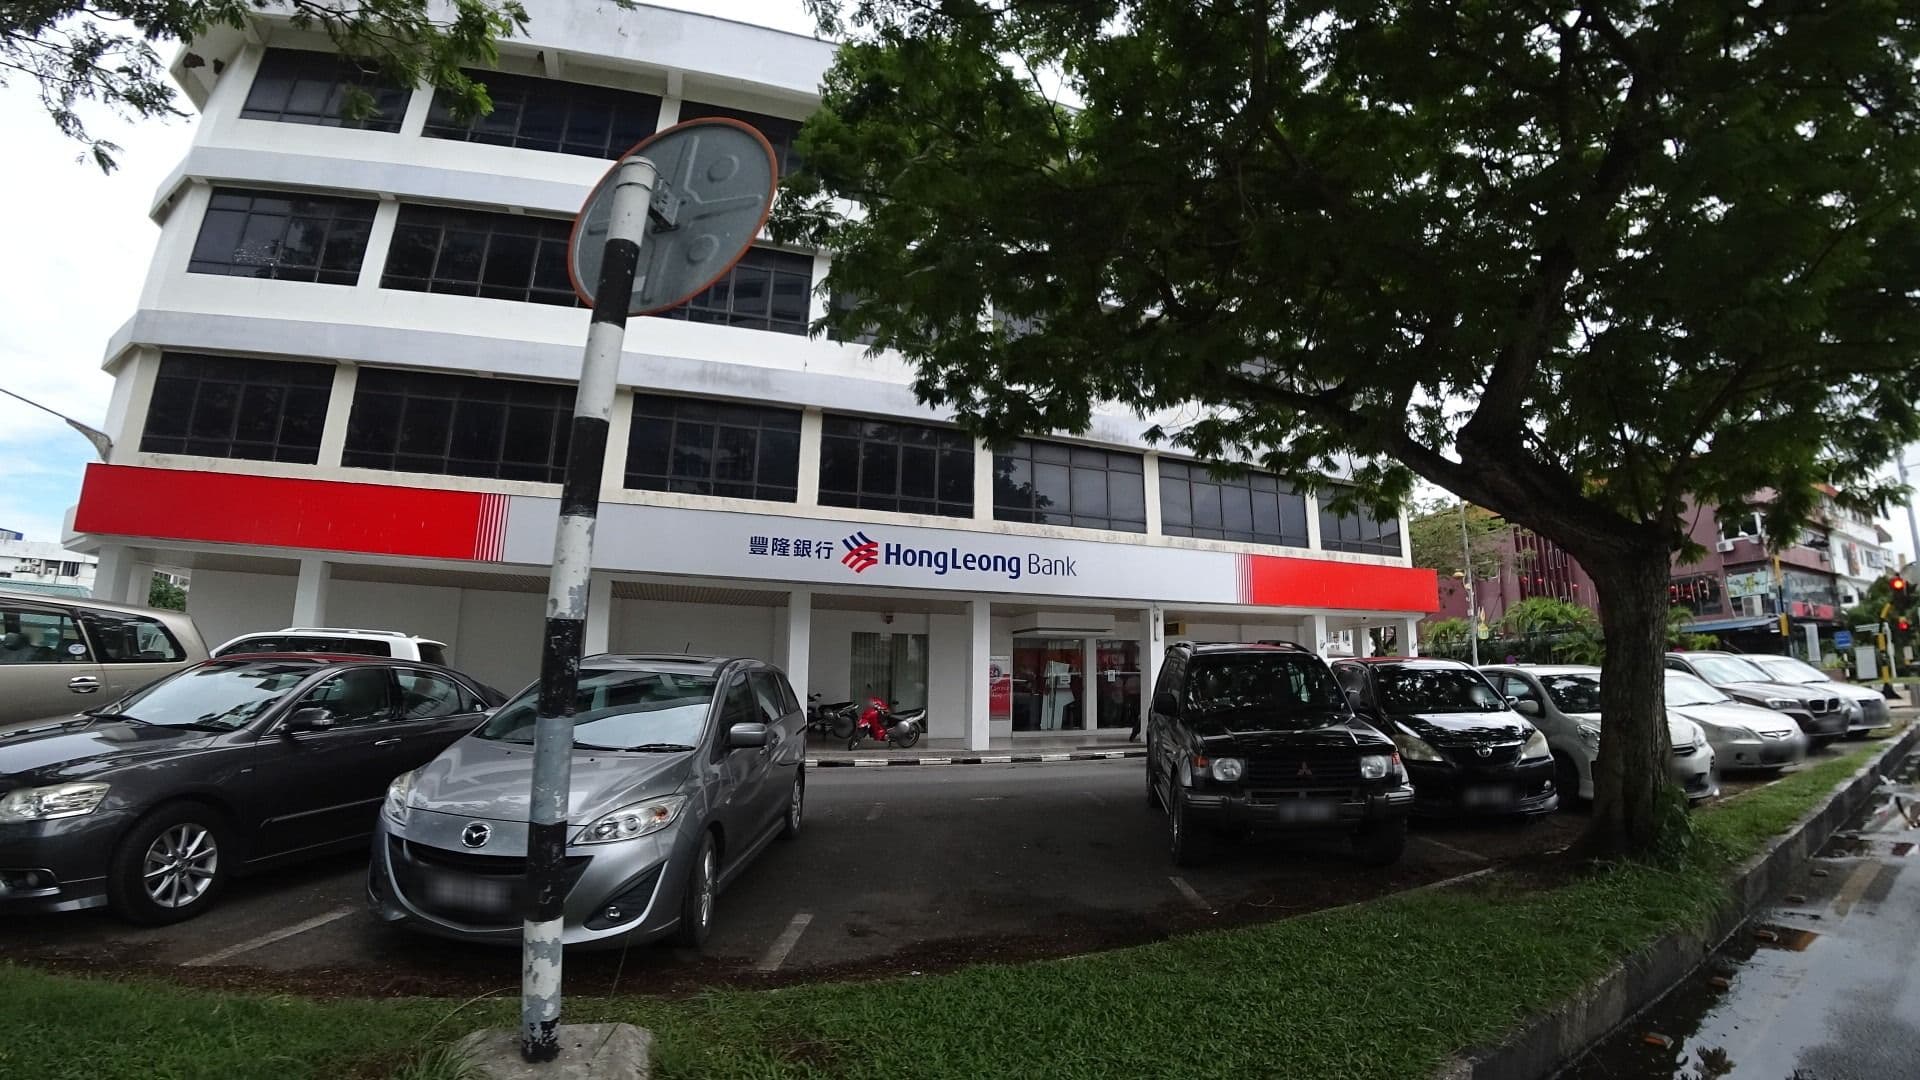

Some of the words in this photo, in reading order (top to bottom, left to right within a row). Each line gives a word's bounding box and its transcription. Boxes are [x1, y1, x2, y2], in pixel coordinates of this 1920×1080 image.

[749, 536, 833, 560] 豐隆銀行
[1028, 553, 1077, 577] Bank
